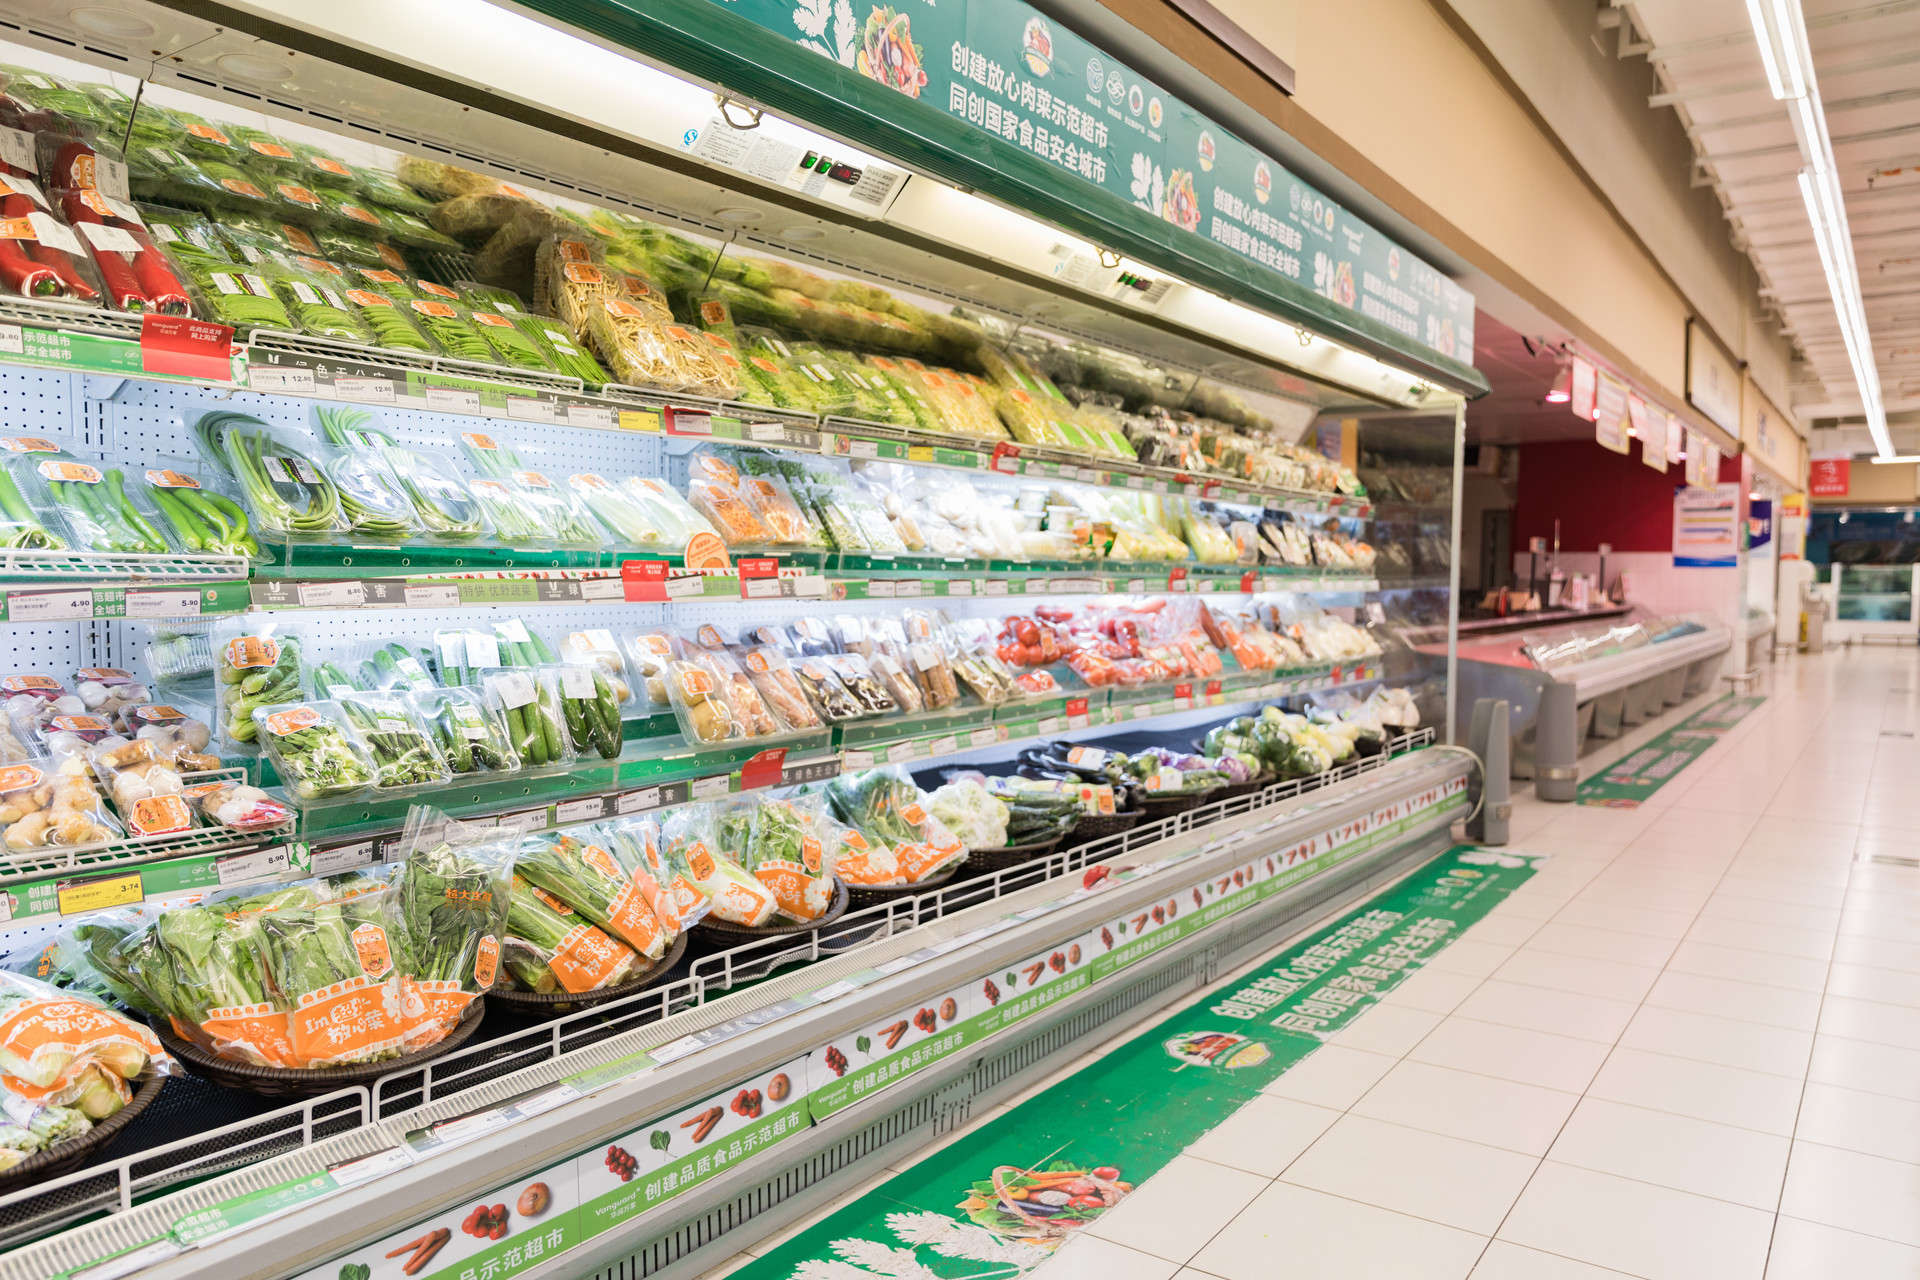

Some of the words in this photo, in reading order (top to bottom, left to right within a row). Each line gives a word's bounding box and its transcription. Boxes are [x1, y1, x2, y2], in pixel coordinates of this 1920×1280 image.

[951, 40, 1109, 149] 创建放心肉菜示范超市
[949, 81, 1107, 184] 同创国家食品安全城市
[24, 331, 71, 347] 示范超市
[24, 344, 73, 361] 安全城市
[71, 600, 90, 608] 4.90
[93, 590, 125, 602] 范超市
[181, 599, 198, 607] 5.90
[94, 604, 125, 616] 全城市
[268, 854, 284, 865] 8.90
[358, 847, 373, 857] 6.90
[121, 883, 139, 893] 3.74
[30, 899, 59, 913] 同创
[1210, 908, 1403, 1020] 创建放心肉菜示范超市
[1270, 916, 1456, 1033] 同创国家食品安全城市
[1002, 973, 1086, 1023] 创建品质食品示范超市
[305, 1016, 330, 1035] I'm
[327, 1008, 386, 1045] 放心菜
[852, 1031, 964, 1096] 创建品质食品示范超市
[818, 1085, 847, 1104] Vanguard
[644, 1111, 800, 1202] 创建品质食品示范超市
[595, 1190, 637, 1216] Vanguard
[610, 1202, 637, 1220] 华润万家
[179, 1218, 229, 1243] 安全城市
